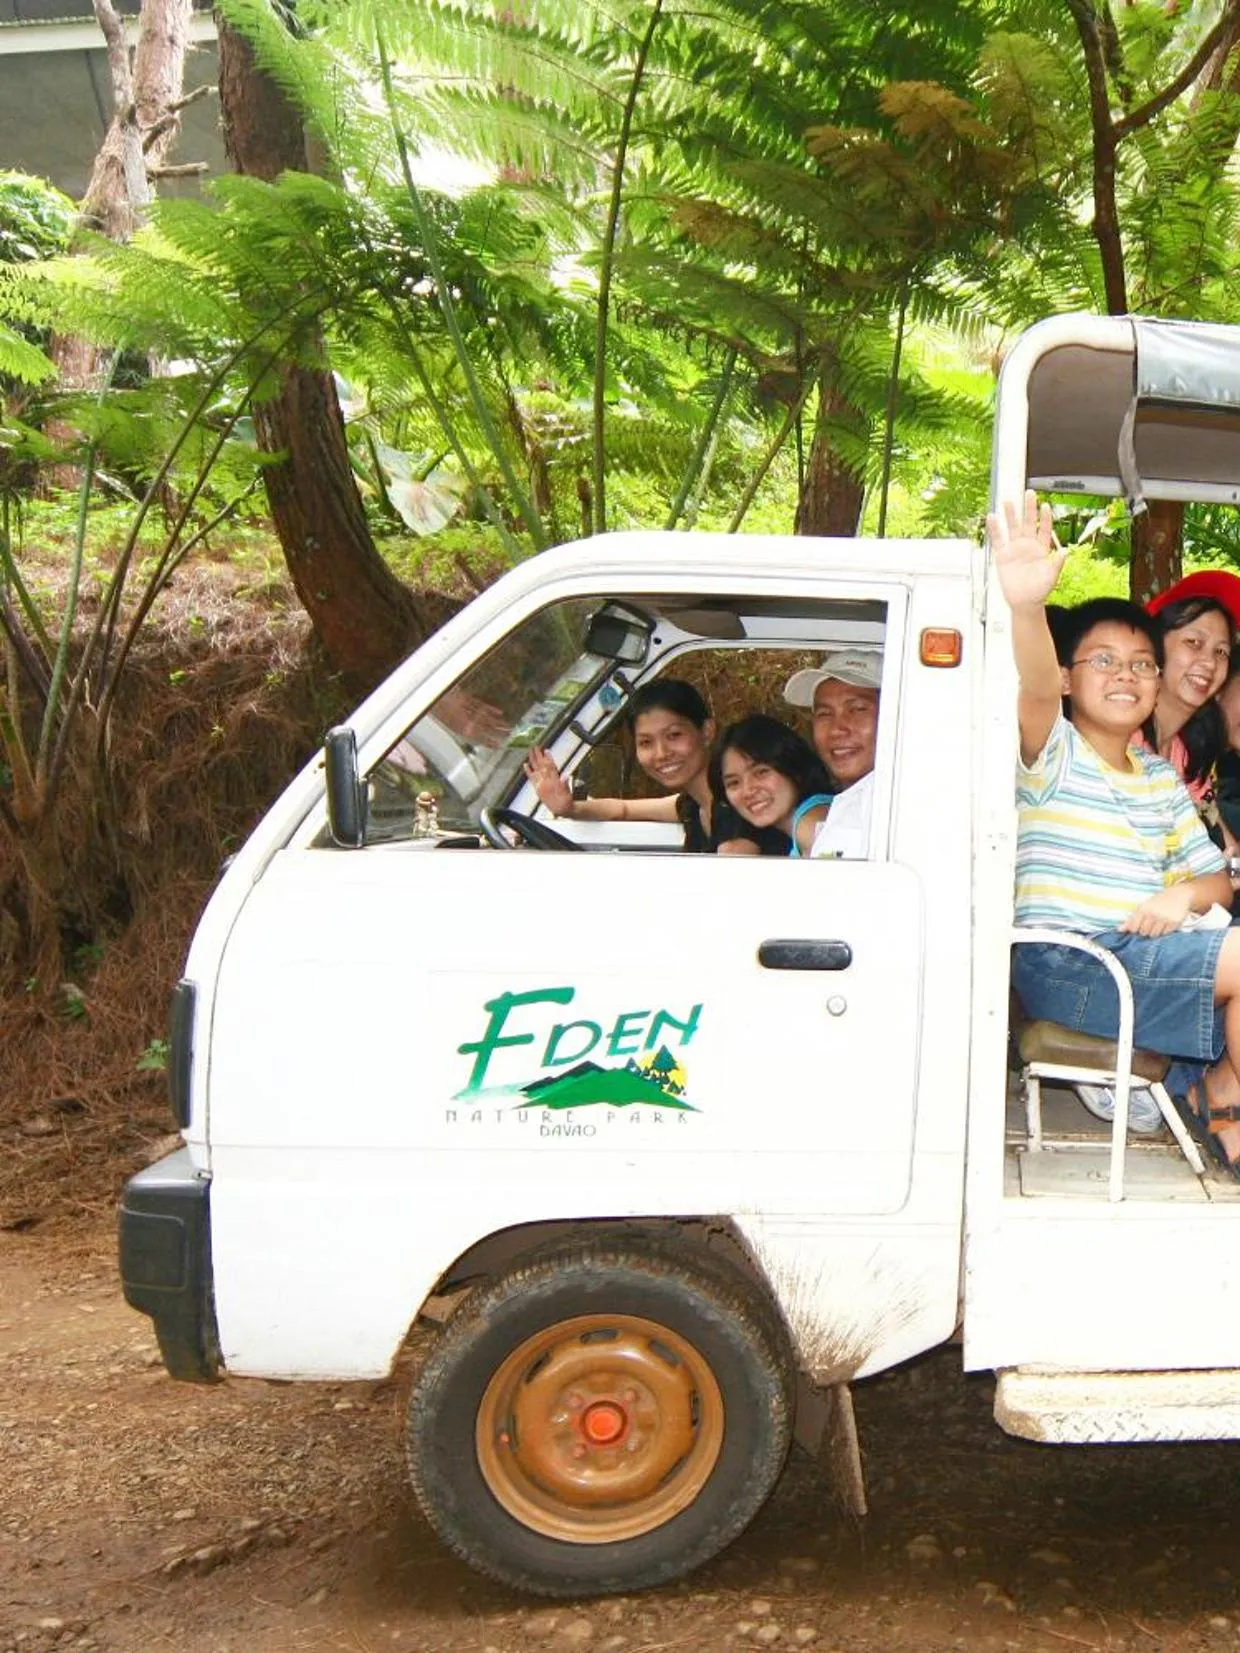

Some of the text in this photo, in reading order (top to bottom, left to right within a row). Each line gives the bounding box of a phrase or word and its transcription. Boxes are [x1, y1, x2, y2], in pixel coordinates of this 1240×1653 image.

[445, 1109, 688, 1124] NATURE PARK
[540, 1124, 596, 1137] DAVAO
